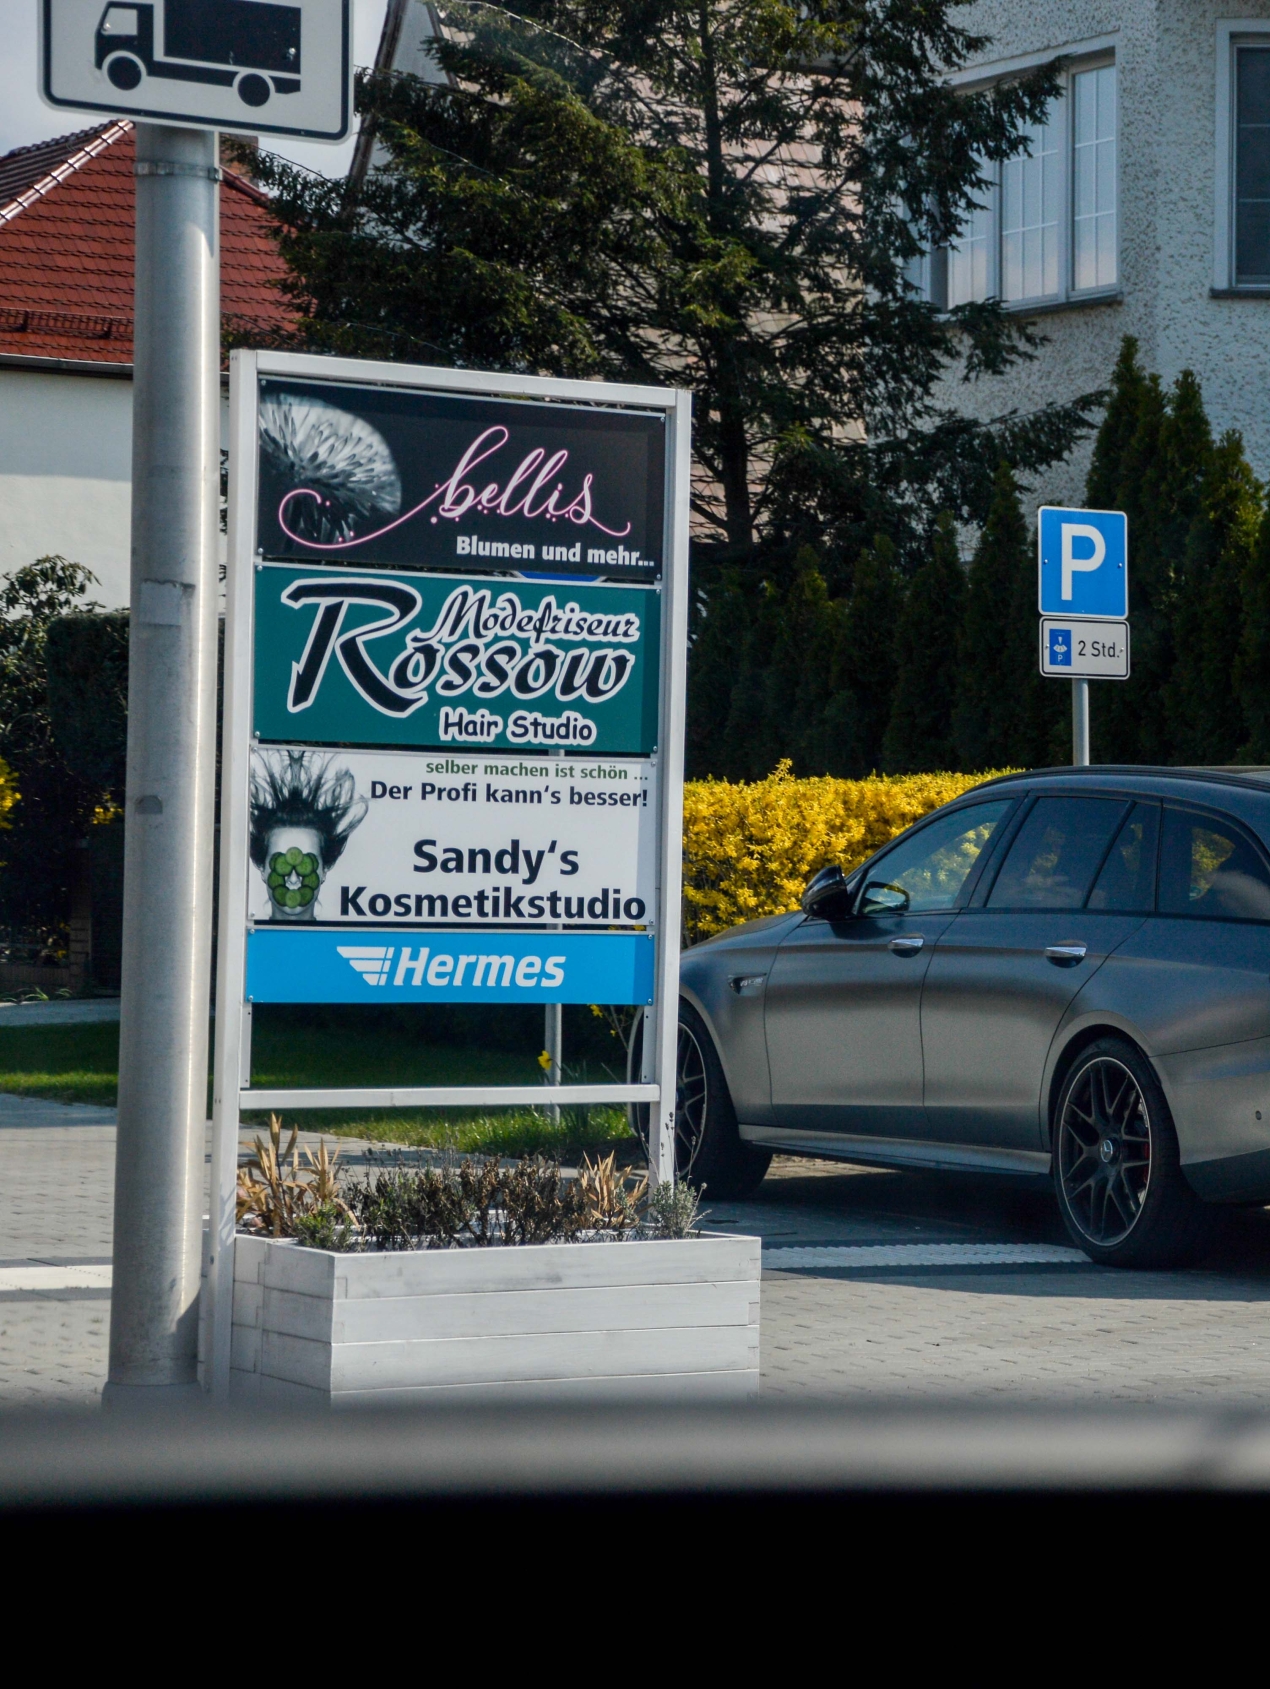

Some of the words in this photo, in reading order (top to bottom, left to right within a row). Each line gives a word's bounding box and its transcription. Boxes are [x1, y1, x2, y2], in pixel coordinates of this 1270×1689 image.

[432, 425, 631, 537] bellis
[456, 536, 535, 561] Blumen
[541, 541, 581, 563] und
[586, 546, 655, 567] mehr...
[1061, 523, 1106, 601] P
[408, 585, 639, 644] Modefriseur
[282, 578, 636, 717] Rossow
[1077, 640, 1087, 657] 2
[1091, 641, 1120, 658] Std.
[440, 708, 500, 740] Hair
[508, 712, 594, 744] Studio
[425, 759, 479, 776] selber
[483, 762, 549, 778] machen
[555, 763, 575, 778] ist
[579, 764, 628, 781] schön
[370, 780, 412, 801] Der
[421, 781, 478, 803] Profi
[569, 786, 649, 807] besser!
[340, 885, 647, 920] Kosmetikstudio
[394, 947, 567, 988] Hermes
